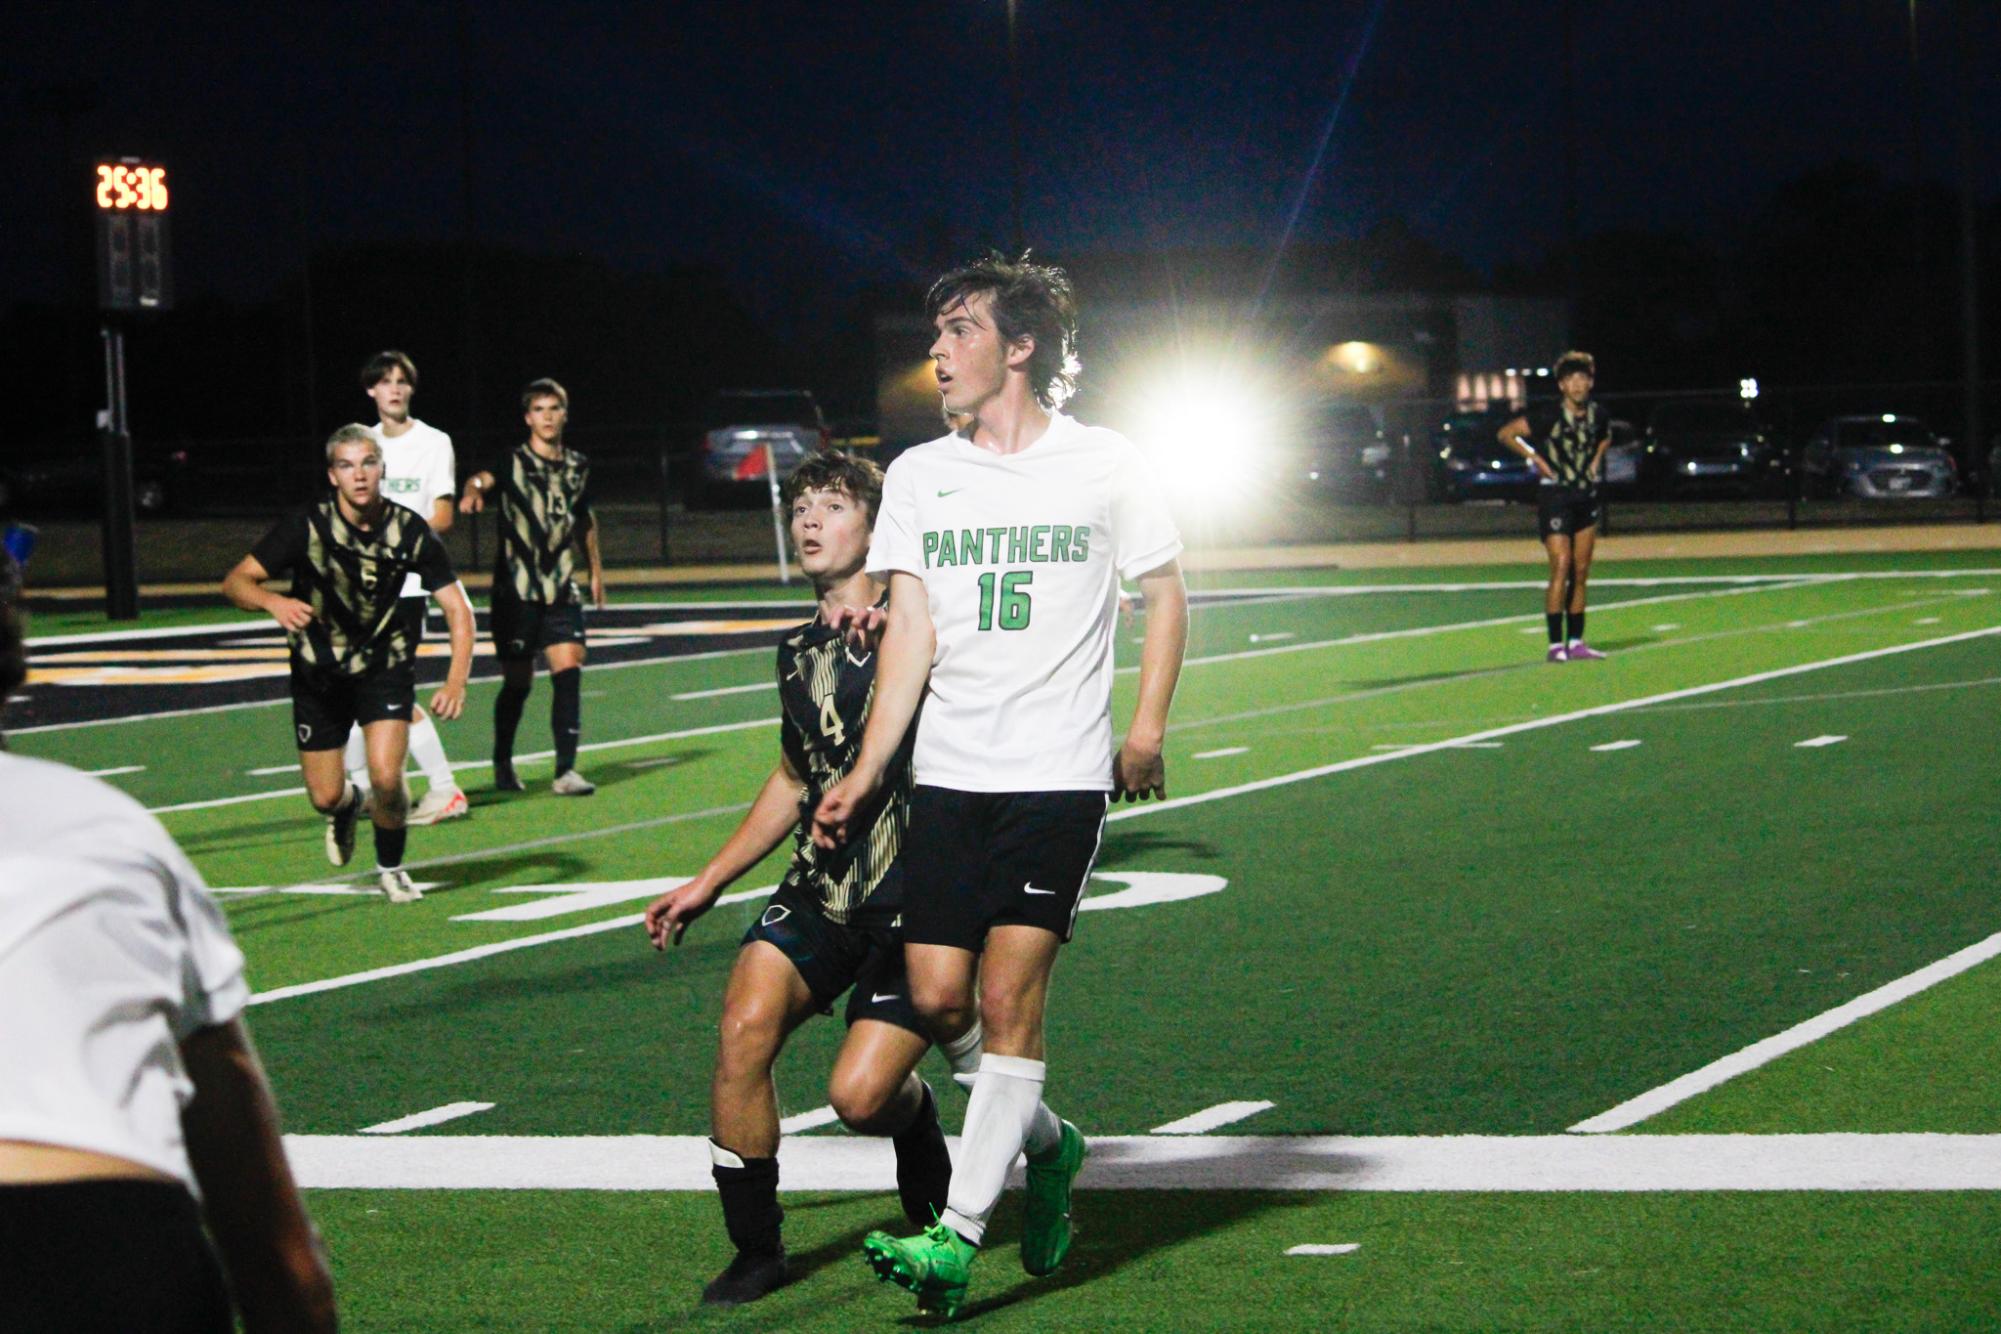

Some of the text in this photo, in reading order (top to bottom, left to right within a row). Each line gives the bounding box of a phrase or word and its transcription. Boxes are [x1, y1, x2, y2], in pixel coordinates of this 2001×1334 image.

[97, 165, 168, 210] 25:36
[922, 525, 1090, 569] PANTHERS
[977, 571, 1033, 631] 16
[819, 695, 846, 746] 4
